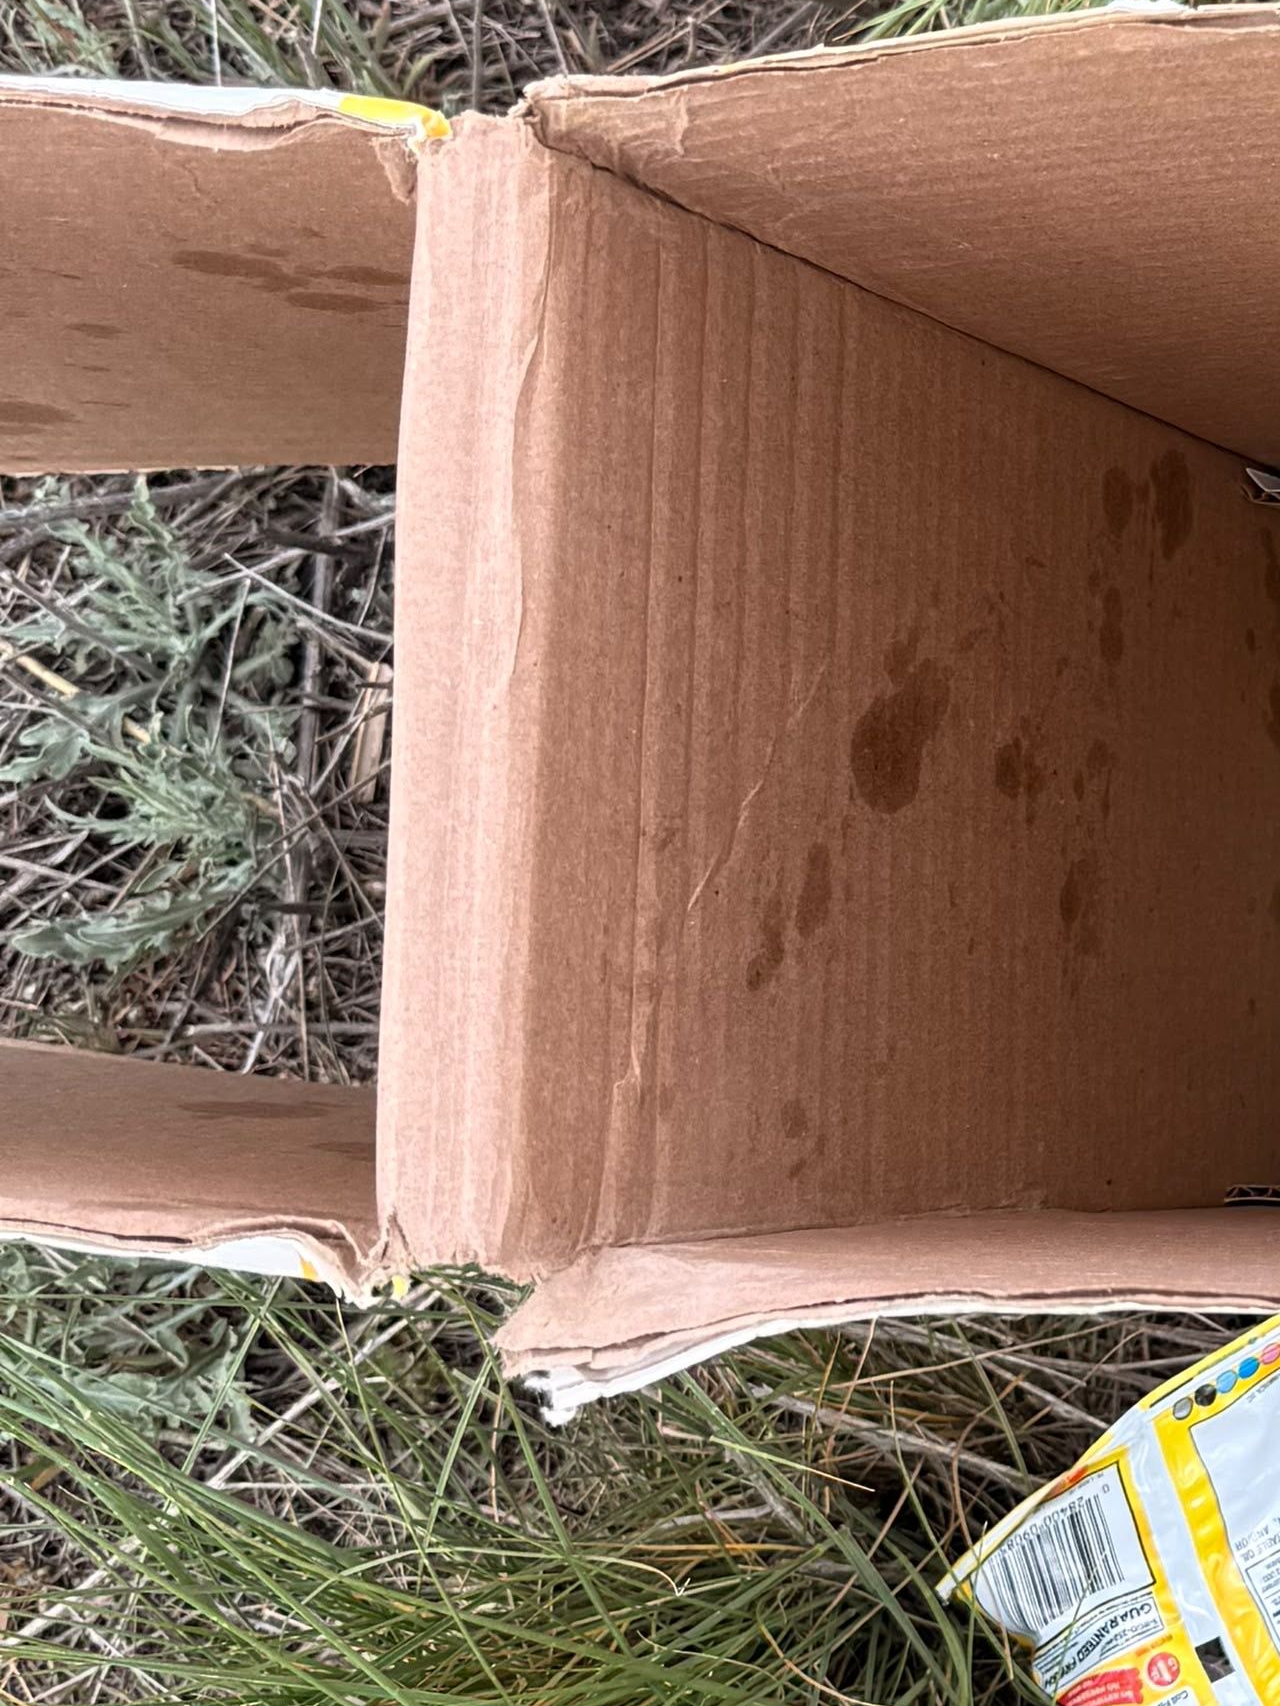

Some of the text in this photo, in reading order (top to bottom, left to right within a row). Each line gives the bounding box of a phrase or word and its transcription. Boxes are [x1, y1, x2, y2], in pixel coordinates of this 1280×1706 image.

[1041, 1482, 1111, 1528] 0 28400
[1074, 1601, 1153, 1664] GUARANTEED
[1169, 1689, 1189, 1704] Call
